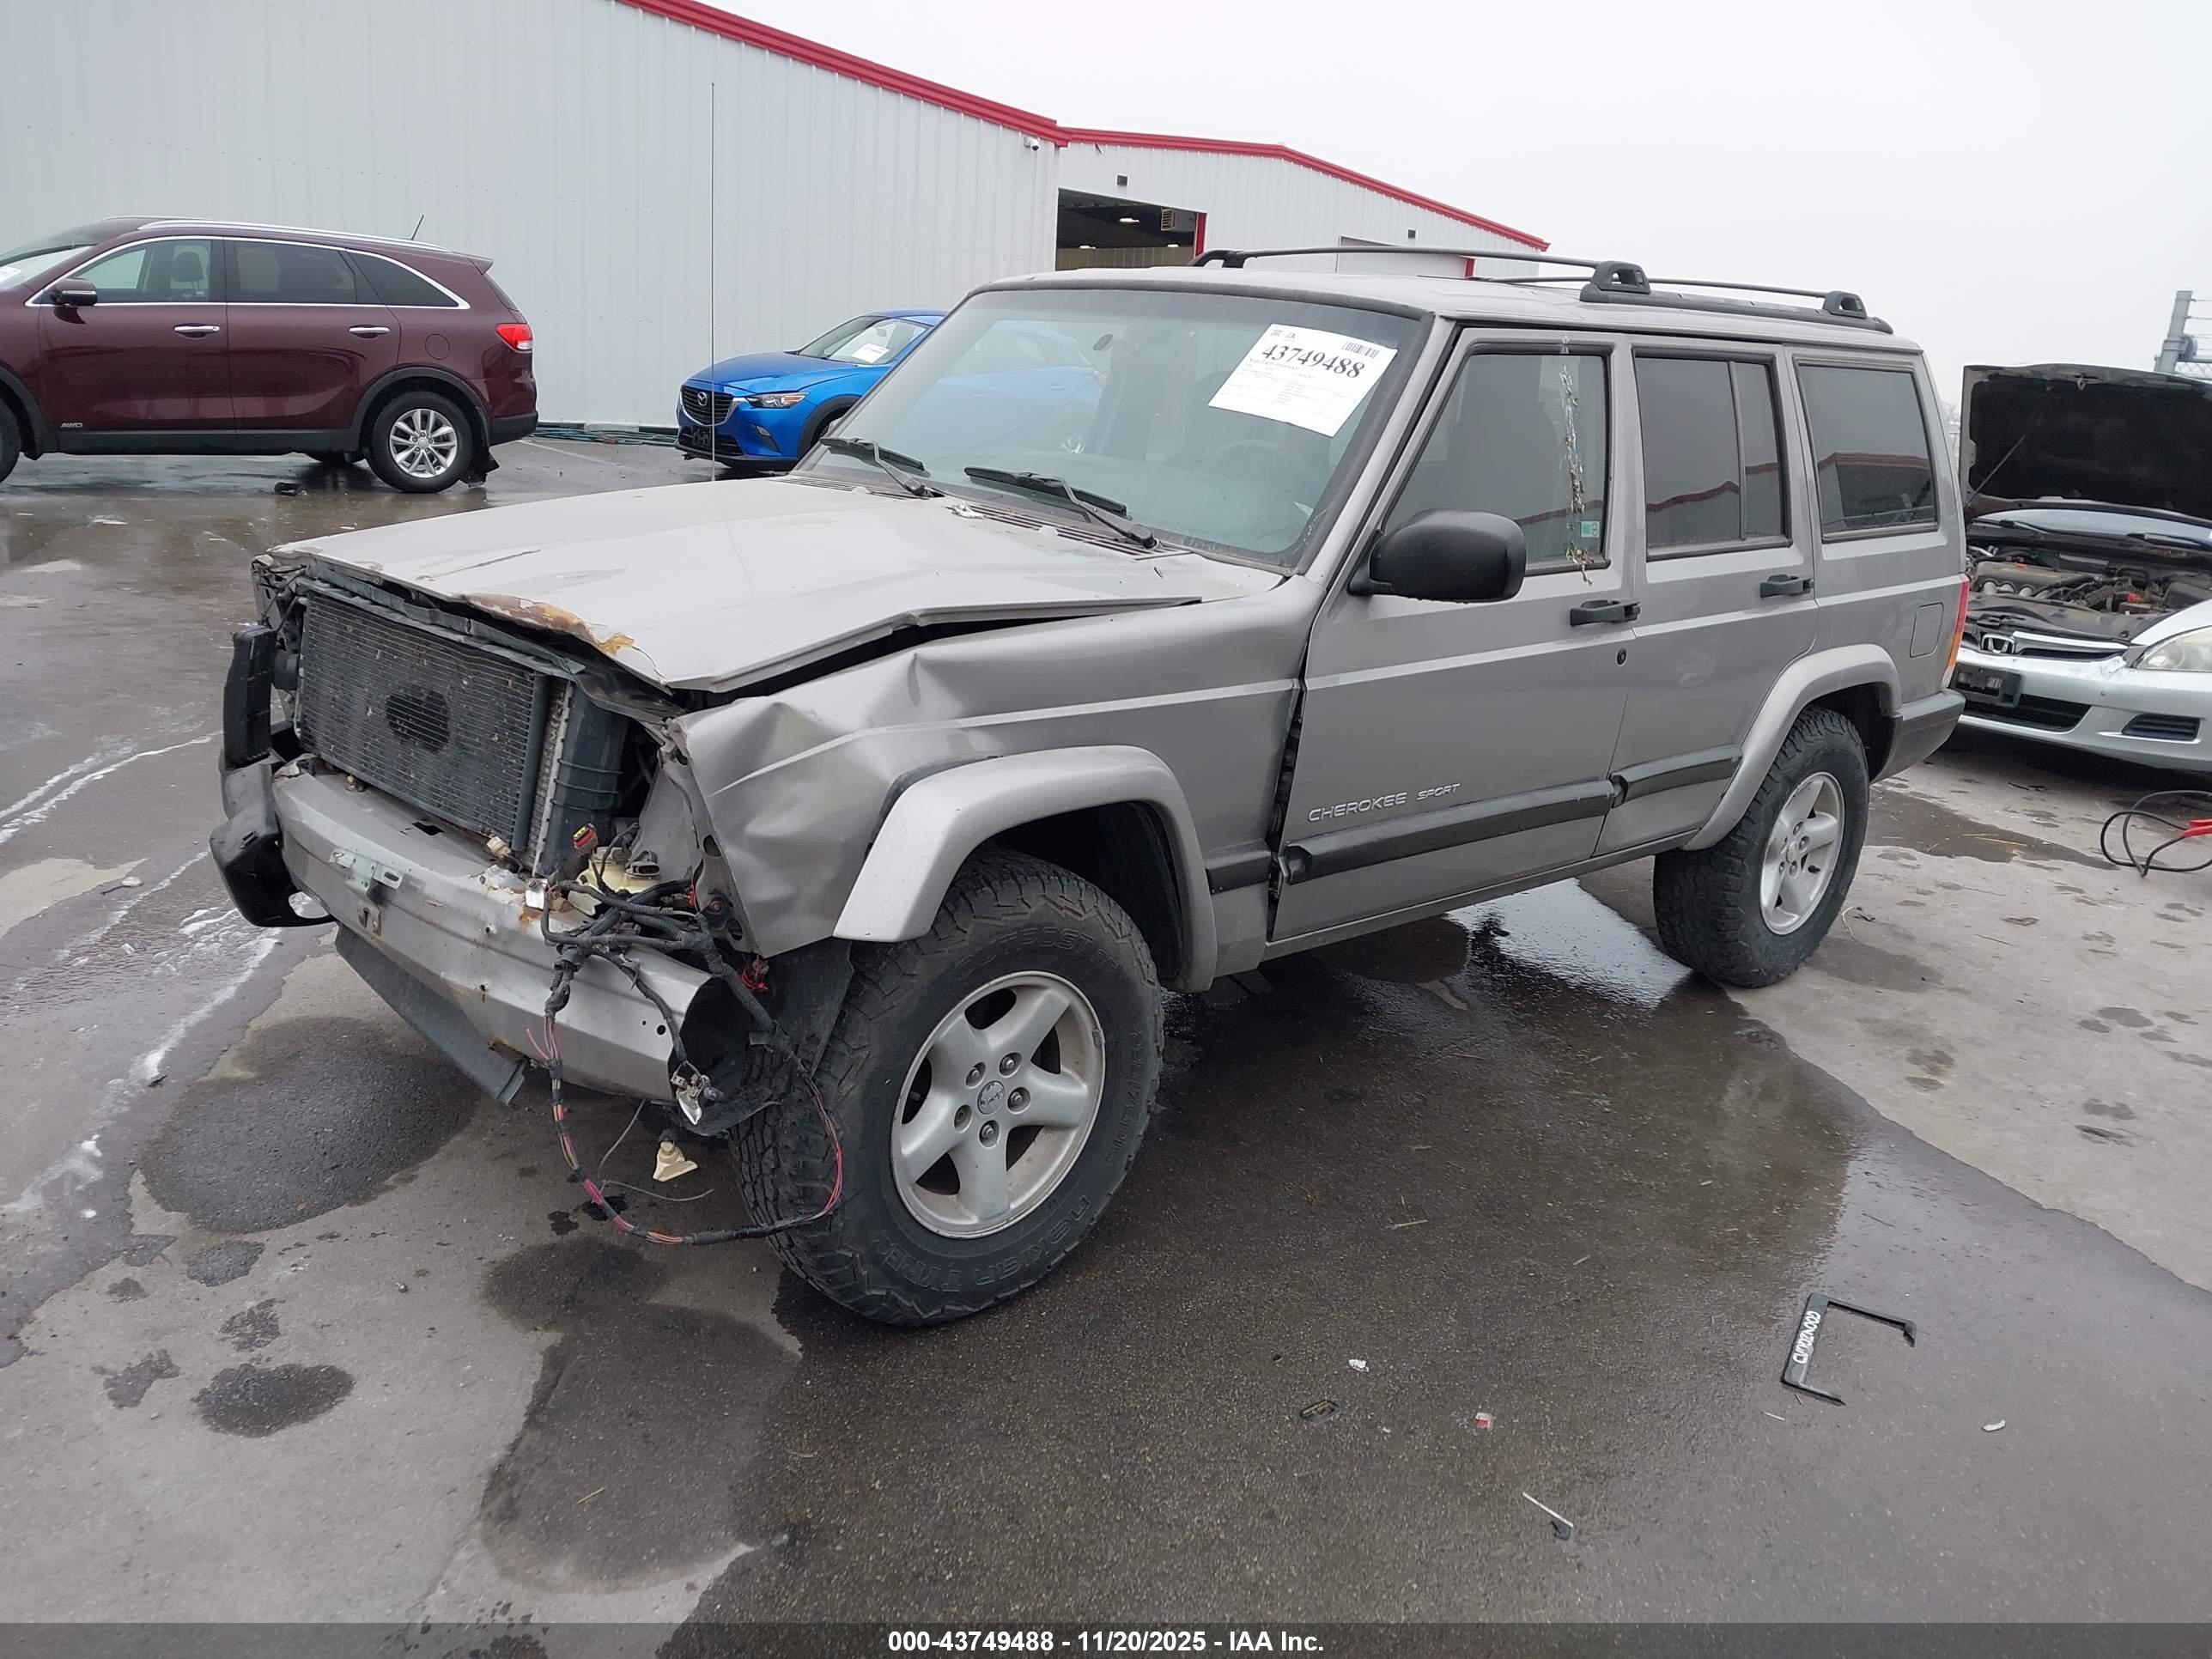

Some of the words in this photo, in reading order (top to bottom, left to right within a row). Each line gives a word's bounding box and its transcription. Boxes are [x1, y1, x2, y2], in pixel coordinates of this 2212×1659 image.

[1261, 343, 1365, 379] 43749488
[1309, 792, 1407, 822] CHEROKEE
[1416, 783, 1461, 800] SPORT
